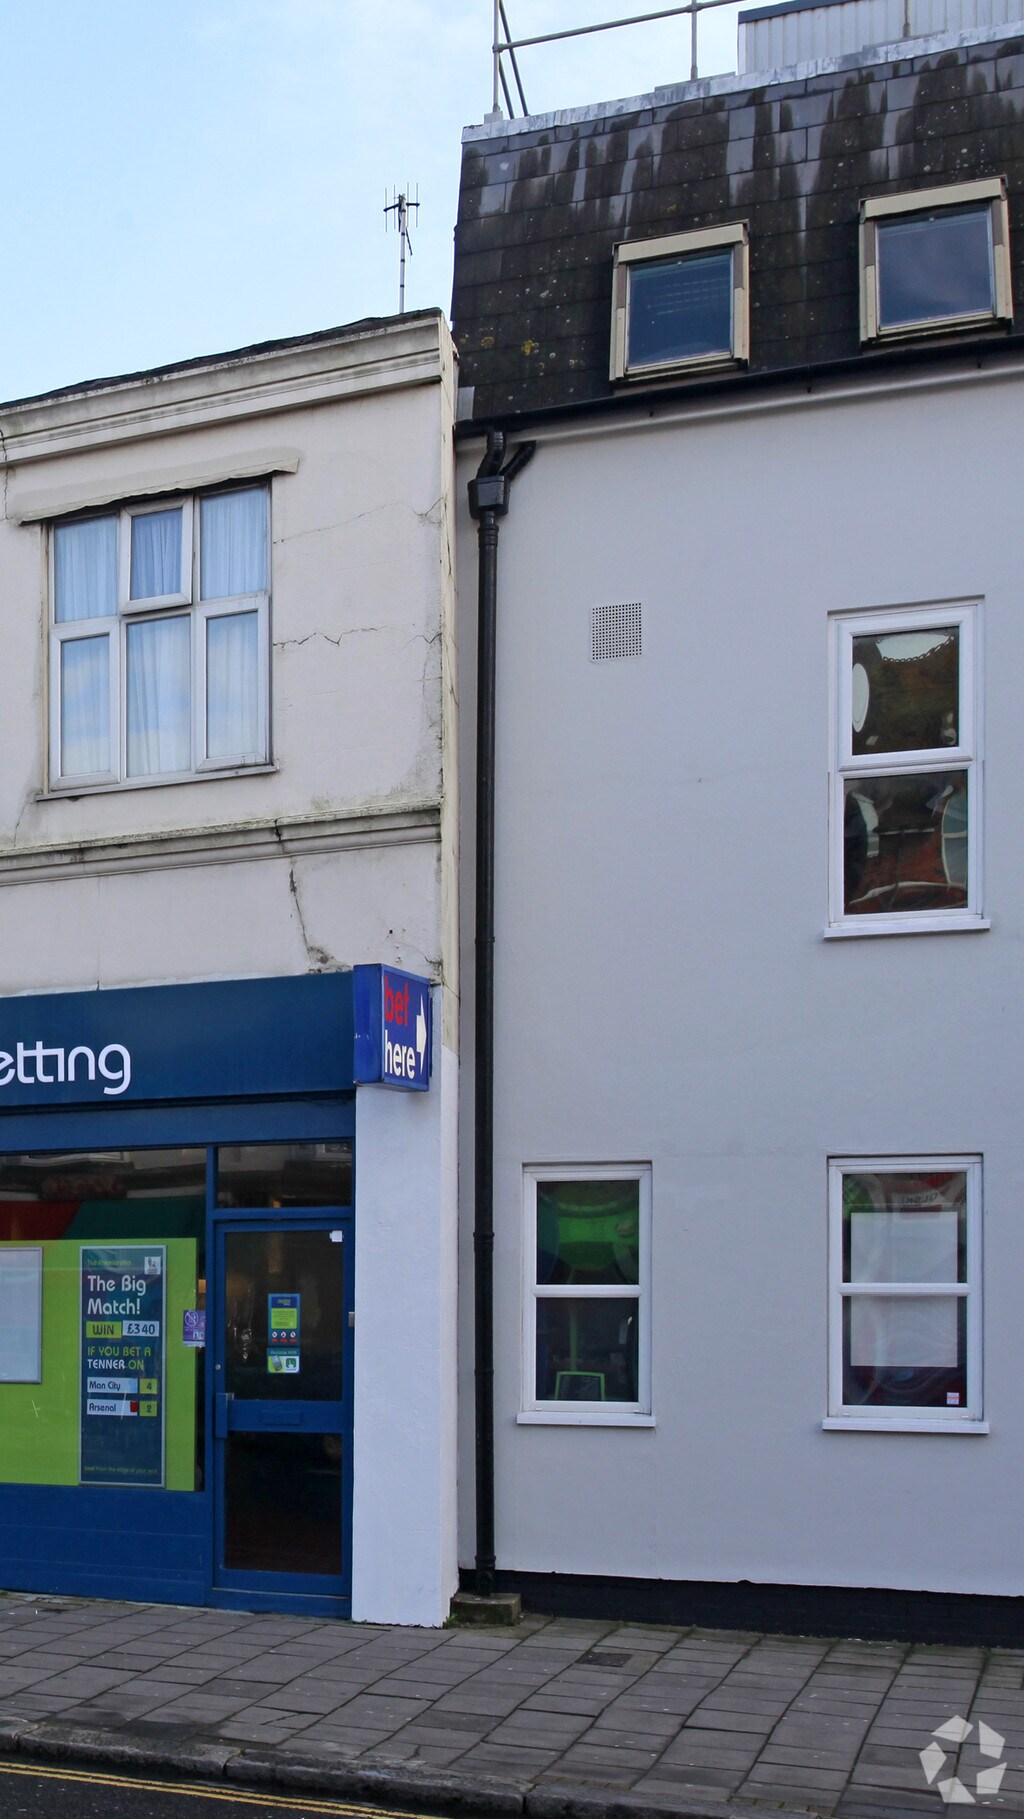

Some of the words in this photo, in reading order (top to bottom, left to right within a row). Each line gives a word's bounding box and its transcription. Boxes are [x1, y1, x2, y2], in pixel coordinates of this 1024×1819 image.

[384, 976, 409, 1027] bet
[384, 1029, 416, 1079] here
[87, 1275, 115, 1292] The
[121, 1275, 146, 1296] Big
[87, 1298, 140, 1315] Match!
[92, 1324, 114, 1335] WIN
[127, 1323, 155, 1335] £340
[87, 1346, 96, 1356] IF
[98, 1346, 120, 1356] YOU
[123, 1346, 141, 1357] BET
[144, 1347, 151, 1357] A
[87, 1359, 125, 1369] TENNER
[128, 1360, 144, 1370] ON
[89, 1381, 106, 1390] Man
[108, 1381, 121, 1391] City
[146, 1382, 152, 1390] 4
[89, 1402, 117, 1412] Arsenal
[146, 1405, 152, 1413] 2
